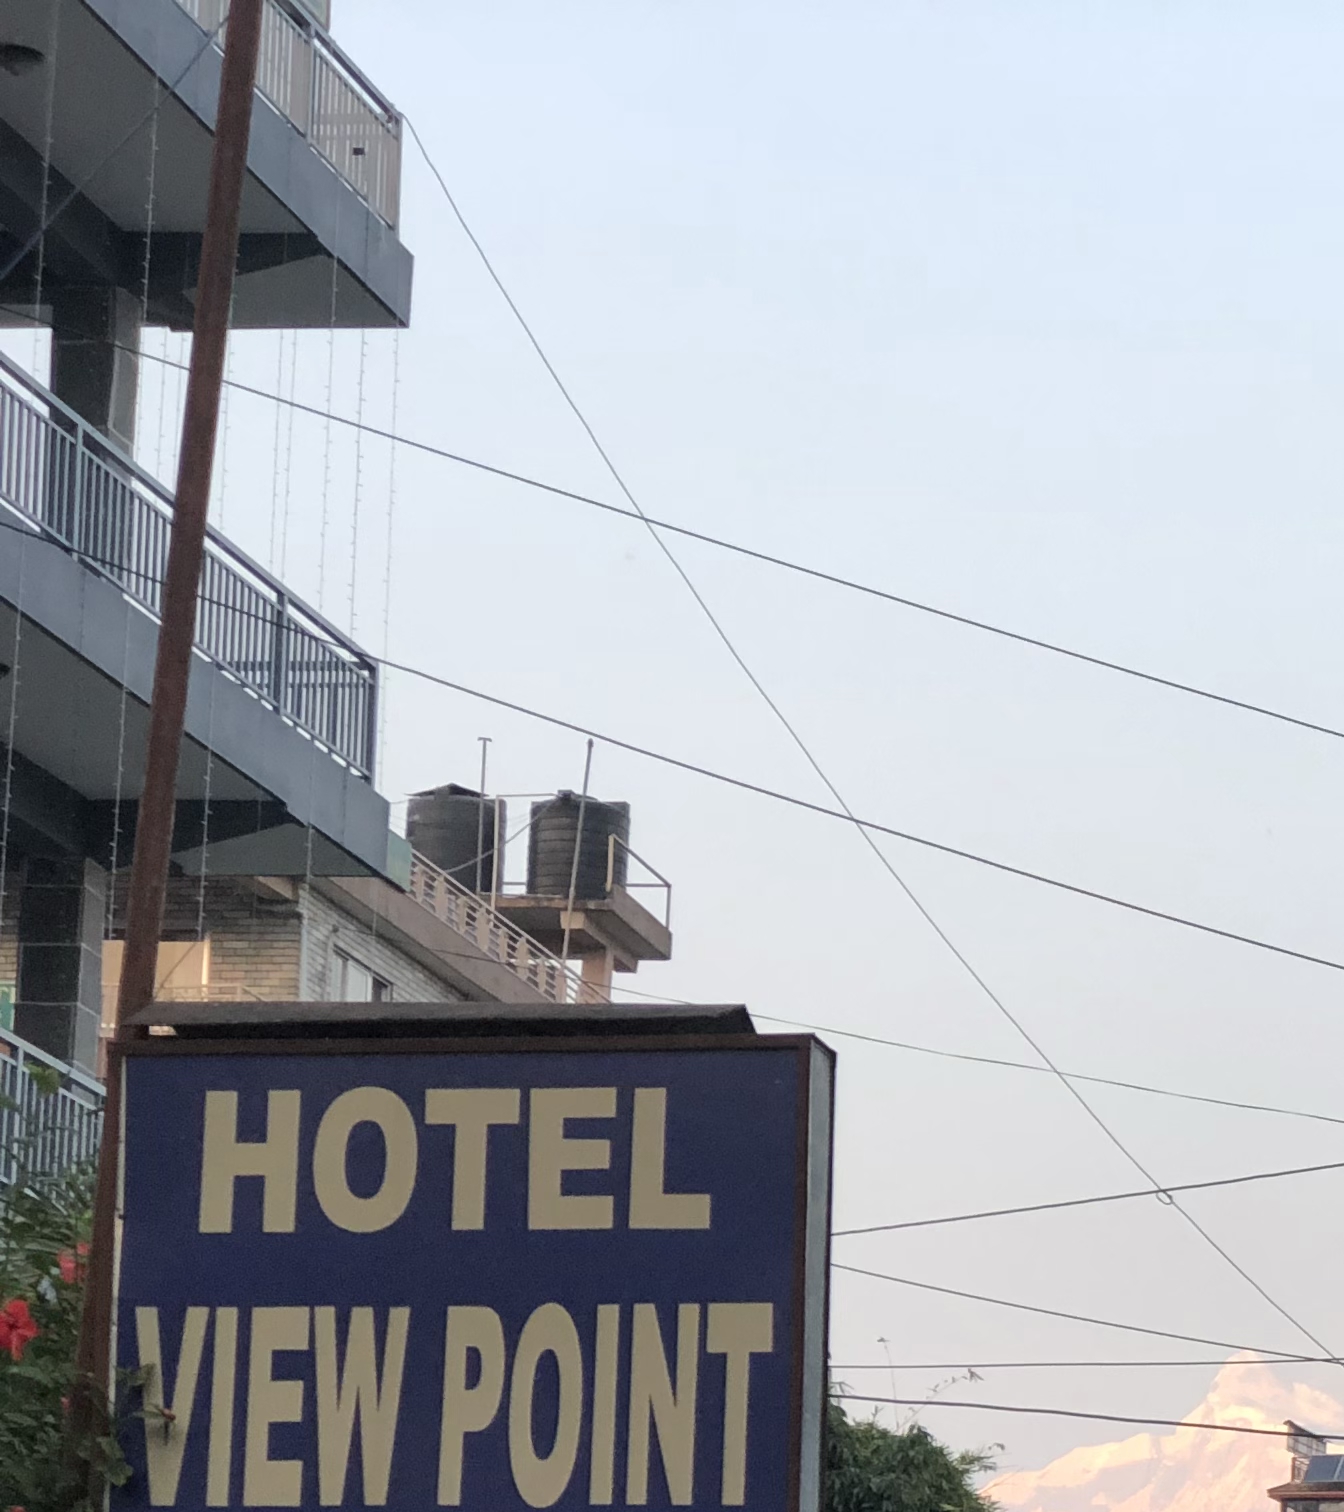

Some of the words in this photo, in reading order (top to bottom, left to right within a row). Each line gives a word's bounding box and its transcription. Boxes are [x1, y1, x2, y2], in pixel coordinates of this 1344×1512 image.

[198, 1085, 712, 1234] HOTEL
[134, 1304, 411, 1508] VIEW
[436, 1301, 775, 1510] POINT
